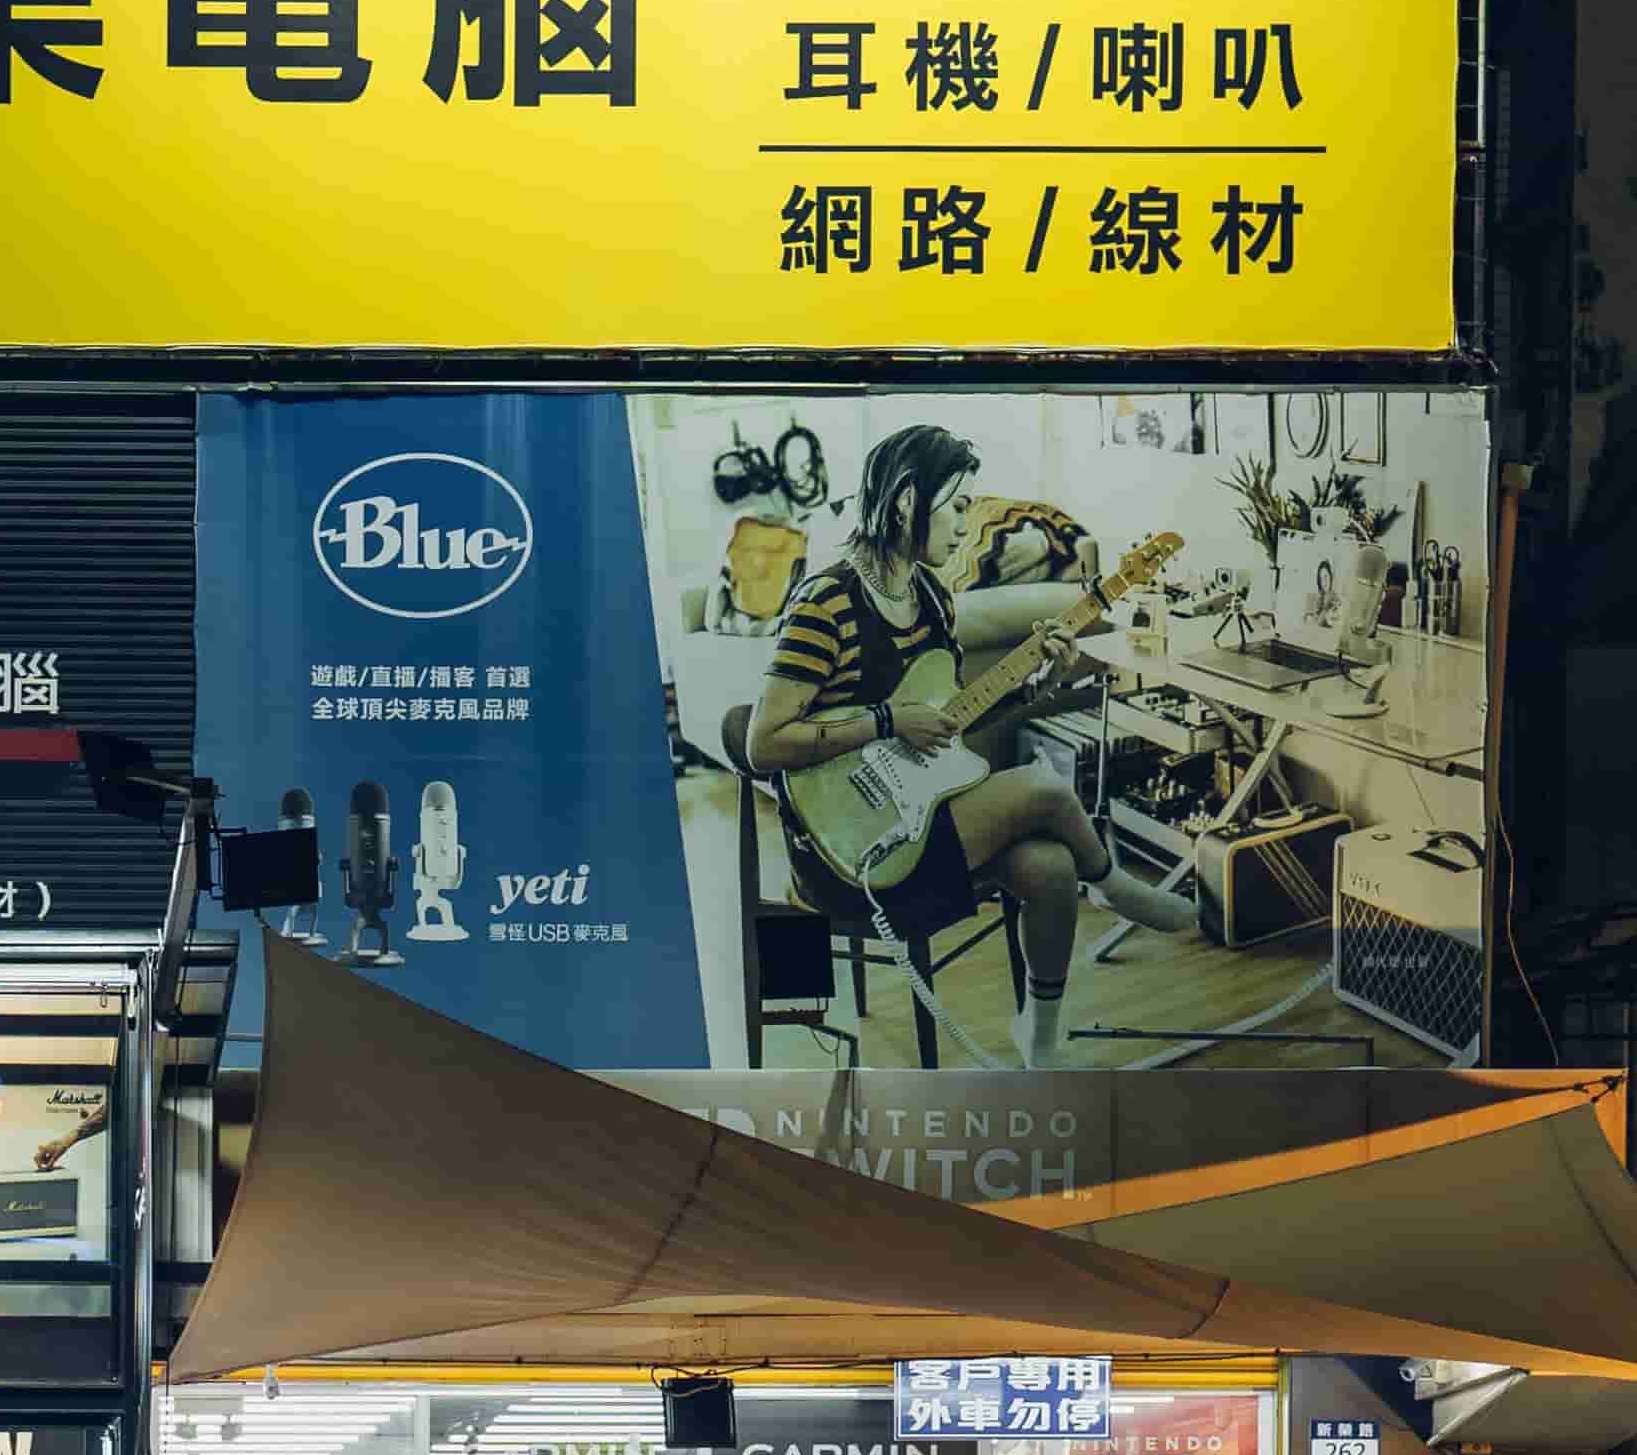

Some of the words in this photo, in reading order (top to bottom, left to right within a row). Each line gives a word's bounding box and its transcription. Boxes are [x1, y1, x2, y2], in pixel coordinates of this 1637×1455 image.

[784, 22, 1303, 113] 耳機/喇叭
[779, 185, 1303, 275] 網路/線材
[329, 496, 520, 570] Blue
[485, 664, 531, 690] 首選
[310, 696, 531, 722] 全球頂尖麥克風品牌
[489, 864, 591, 913] yeti
[776, 1110, 1079, 1137] NINTENDO
[792, 1147, 1078, 1201] WITCH
[909, 1358, 1100, 1391] 客戶專用
[909, 1397, 1101, 1432] 外車勿停
